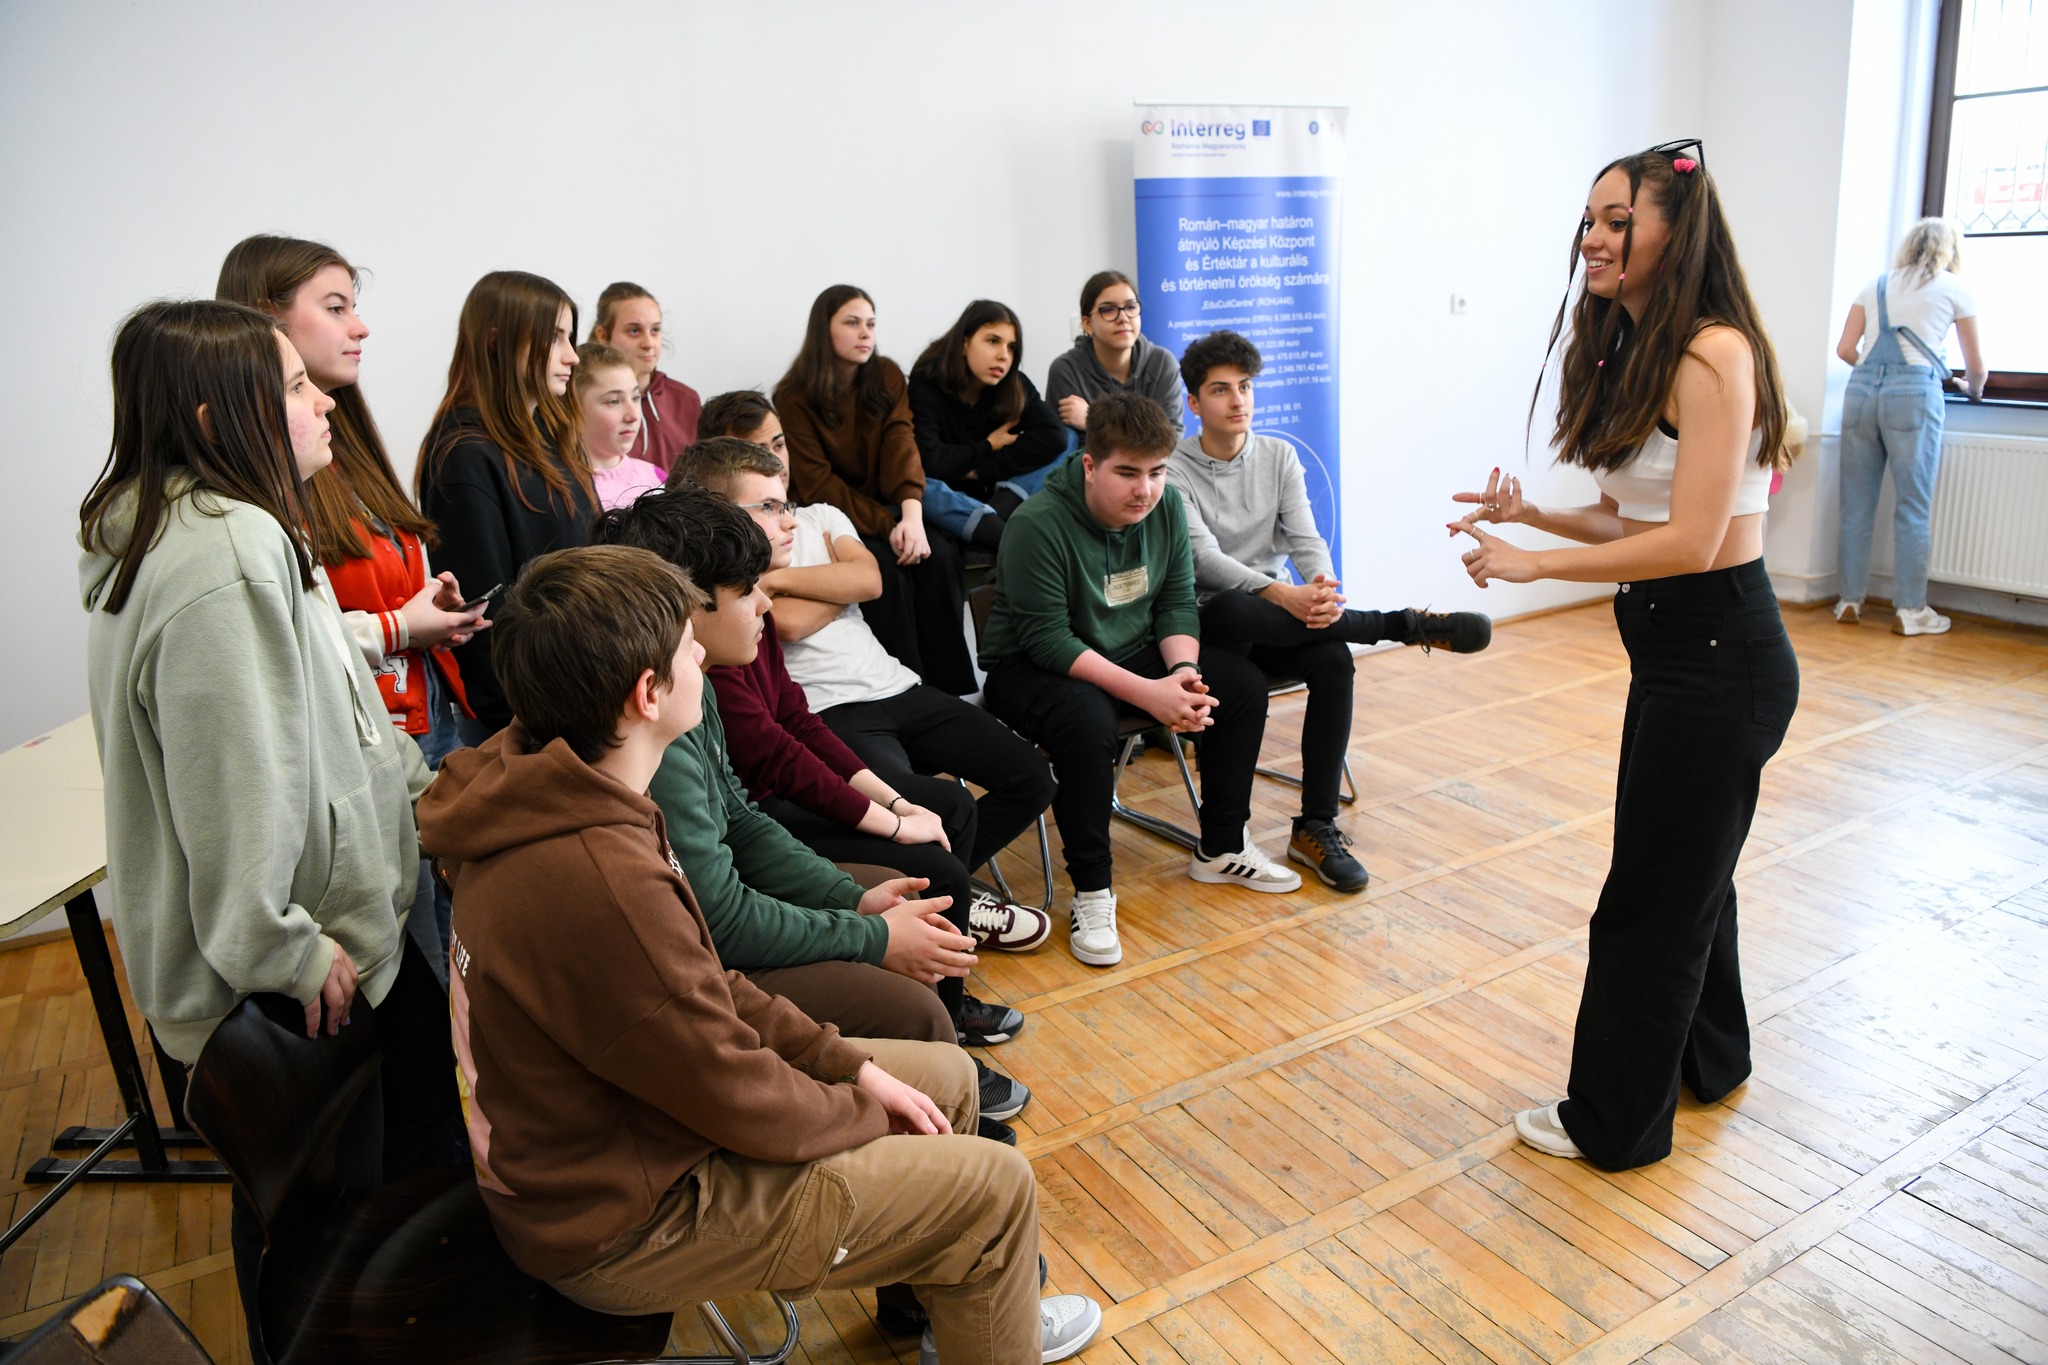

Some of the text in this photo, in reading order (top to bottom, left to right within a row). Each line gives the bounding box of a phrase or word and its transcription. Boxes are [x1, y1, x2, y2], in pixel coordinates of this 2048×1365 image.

[1171, 119, 1246, 140] Interreg
[1271, 216, 1313, 230] határon
[1178, 235, 1315, 254] átnyúló Képzési Központ
[1185, 254, 1309, 271] és Értéktár a kulturális
[1161, 272, 1330, 292] és történelmi örökség számára
